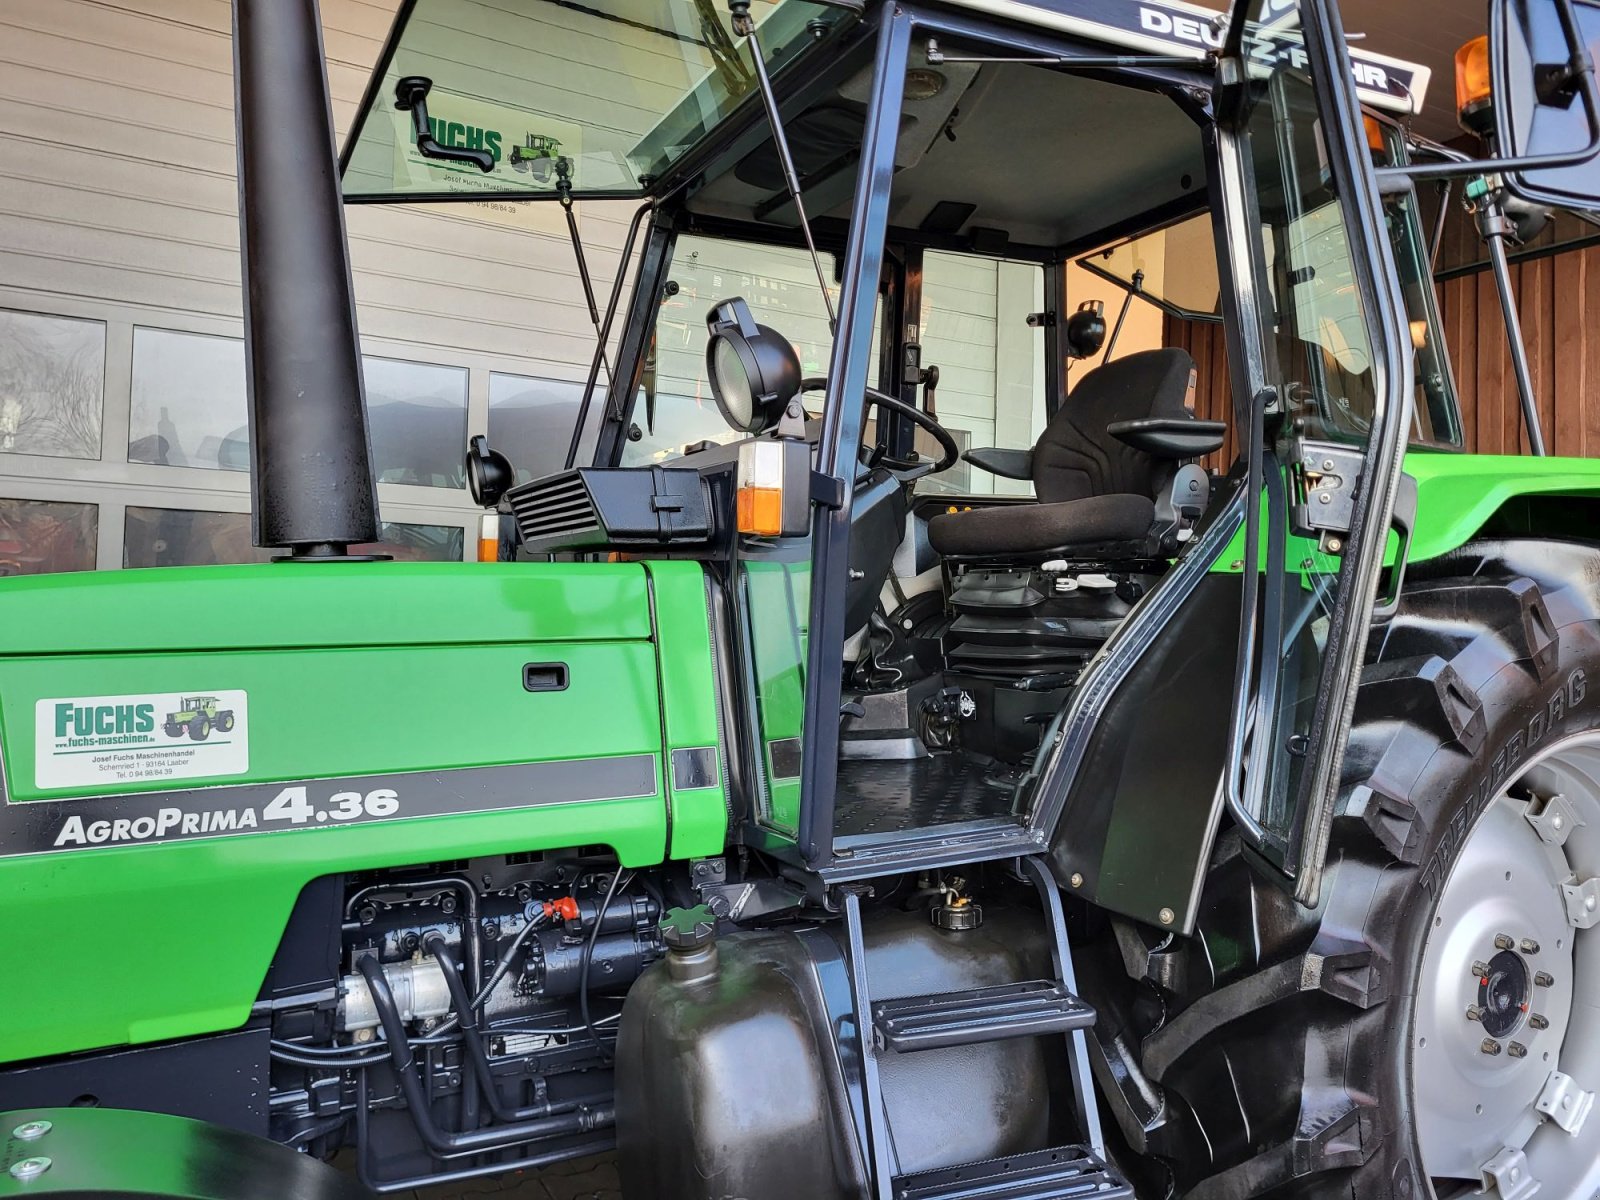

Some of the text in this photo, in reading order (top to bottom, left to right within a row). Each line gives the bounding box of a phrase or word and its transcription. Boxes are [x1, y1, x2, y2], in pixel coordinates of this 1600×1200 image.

[55, 703, 154, 737] FUCHS
[55, 734, 156, 748] www.fuchs-maschinen.de
[92, 749, 195, 763] Josef Fuchs Maschinenhandel
[167, 759, 189, 767] Laaber
[116, 771, 127, 779] Tel.
[1418, 666, 1588, 901] TRELLEBORG
[262, 786, 399, 824] 4.36
